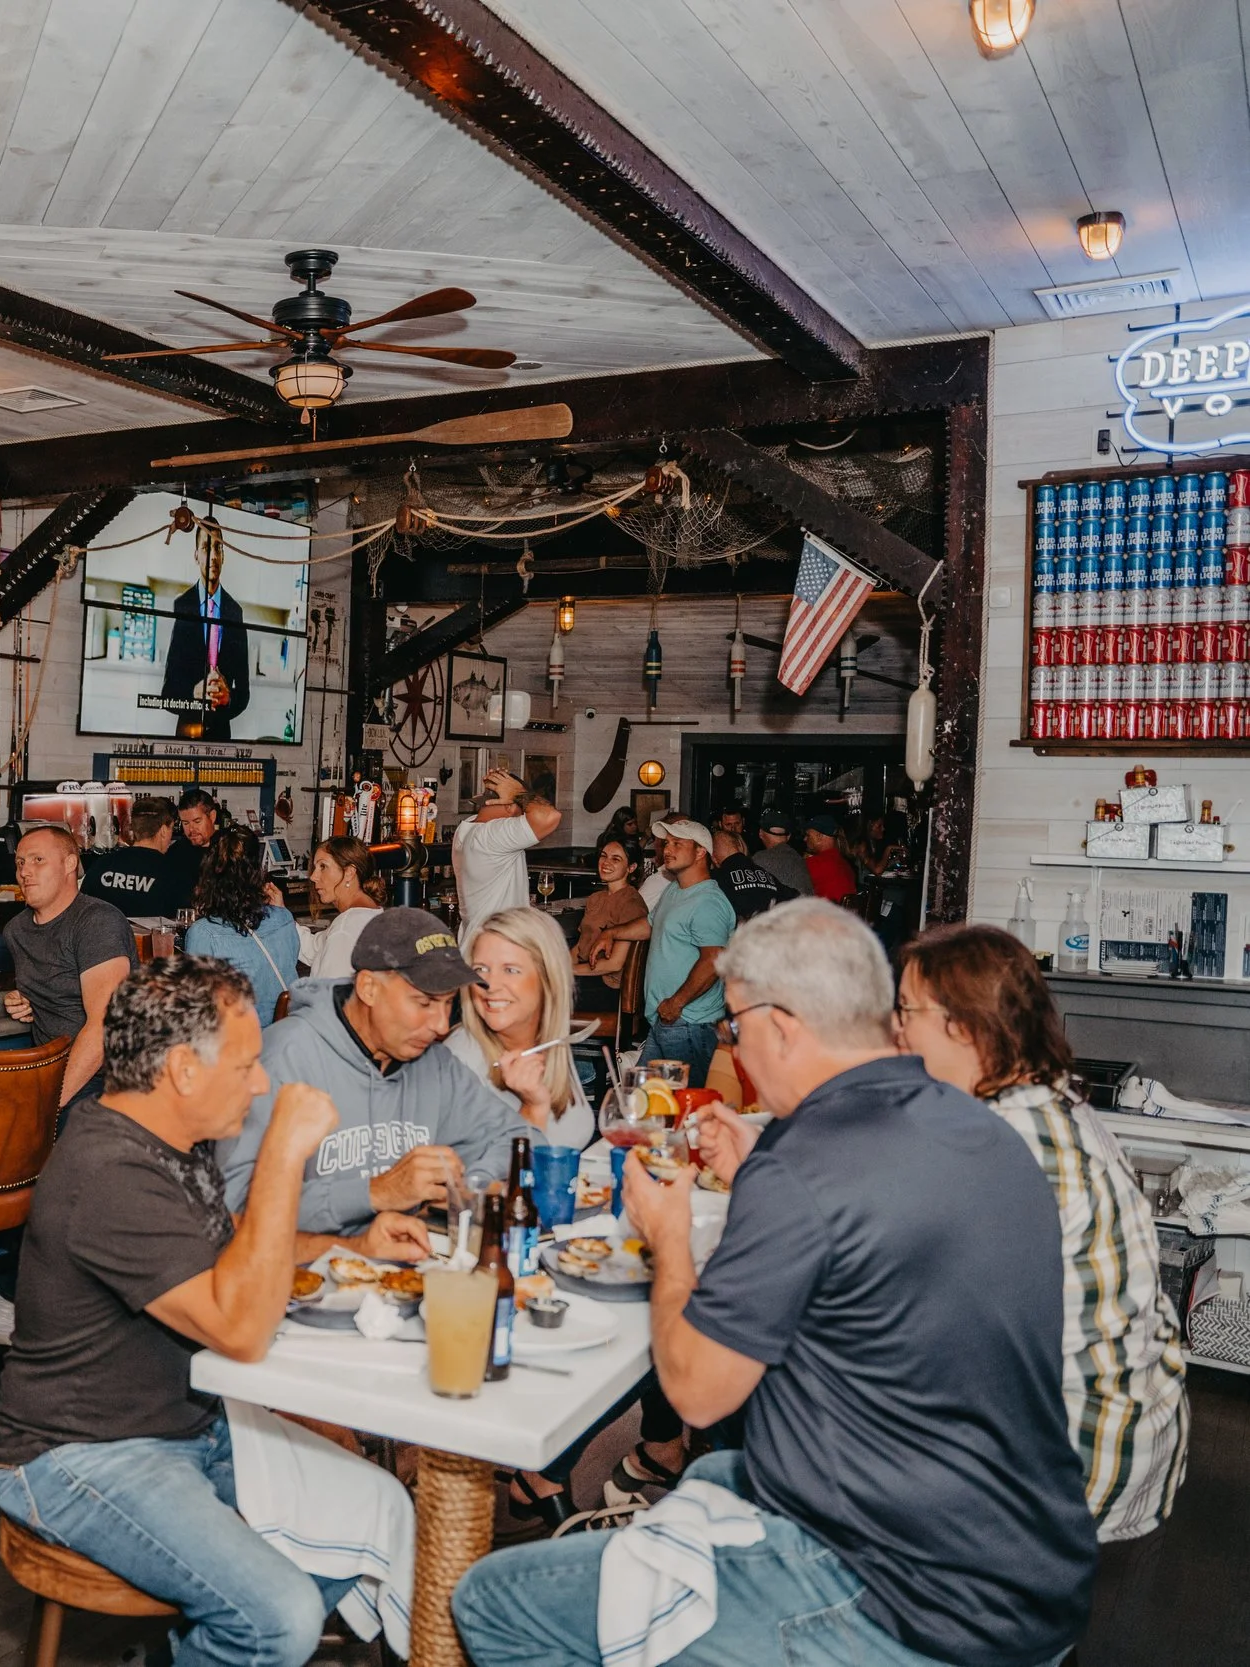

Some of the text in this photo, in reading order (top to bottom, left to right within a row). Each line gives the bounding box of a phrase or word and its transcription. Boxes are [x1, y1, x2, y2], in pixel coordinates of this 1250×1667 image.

[1139, 341, 1250, 388] DEEP
[1104, 502, 1125, 510] LIGHT
[1177, 497, 1200, 505] LIGHT
[1203, 495, 1226, 503] LIGHT
[1176, 535, 1198, 543] LIGHT
[139, 696, 163, 709] including
[169, 699, 189, 710] doctor's
[190, 701, 210, 711] offics.
[164, 744, 184, 755] Shoot
[188, 744, 200, 754] The
[100, 871, 156, 892] CREW
